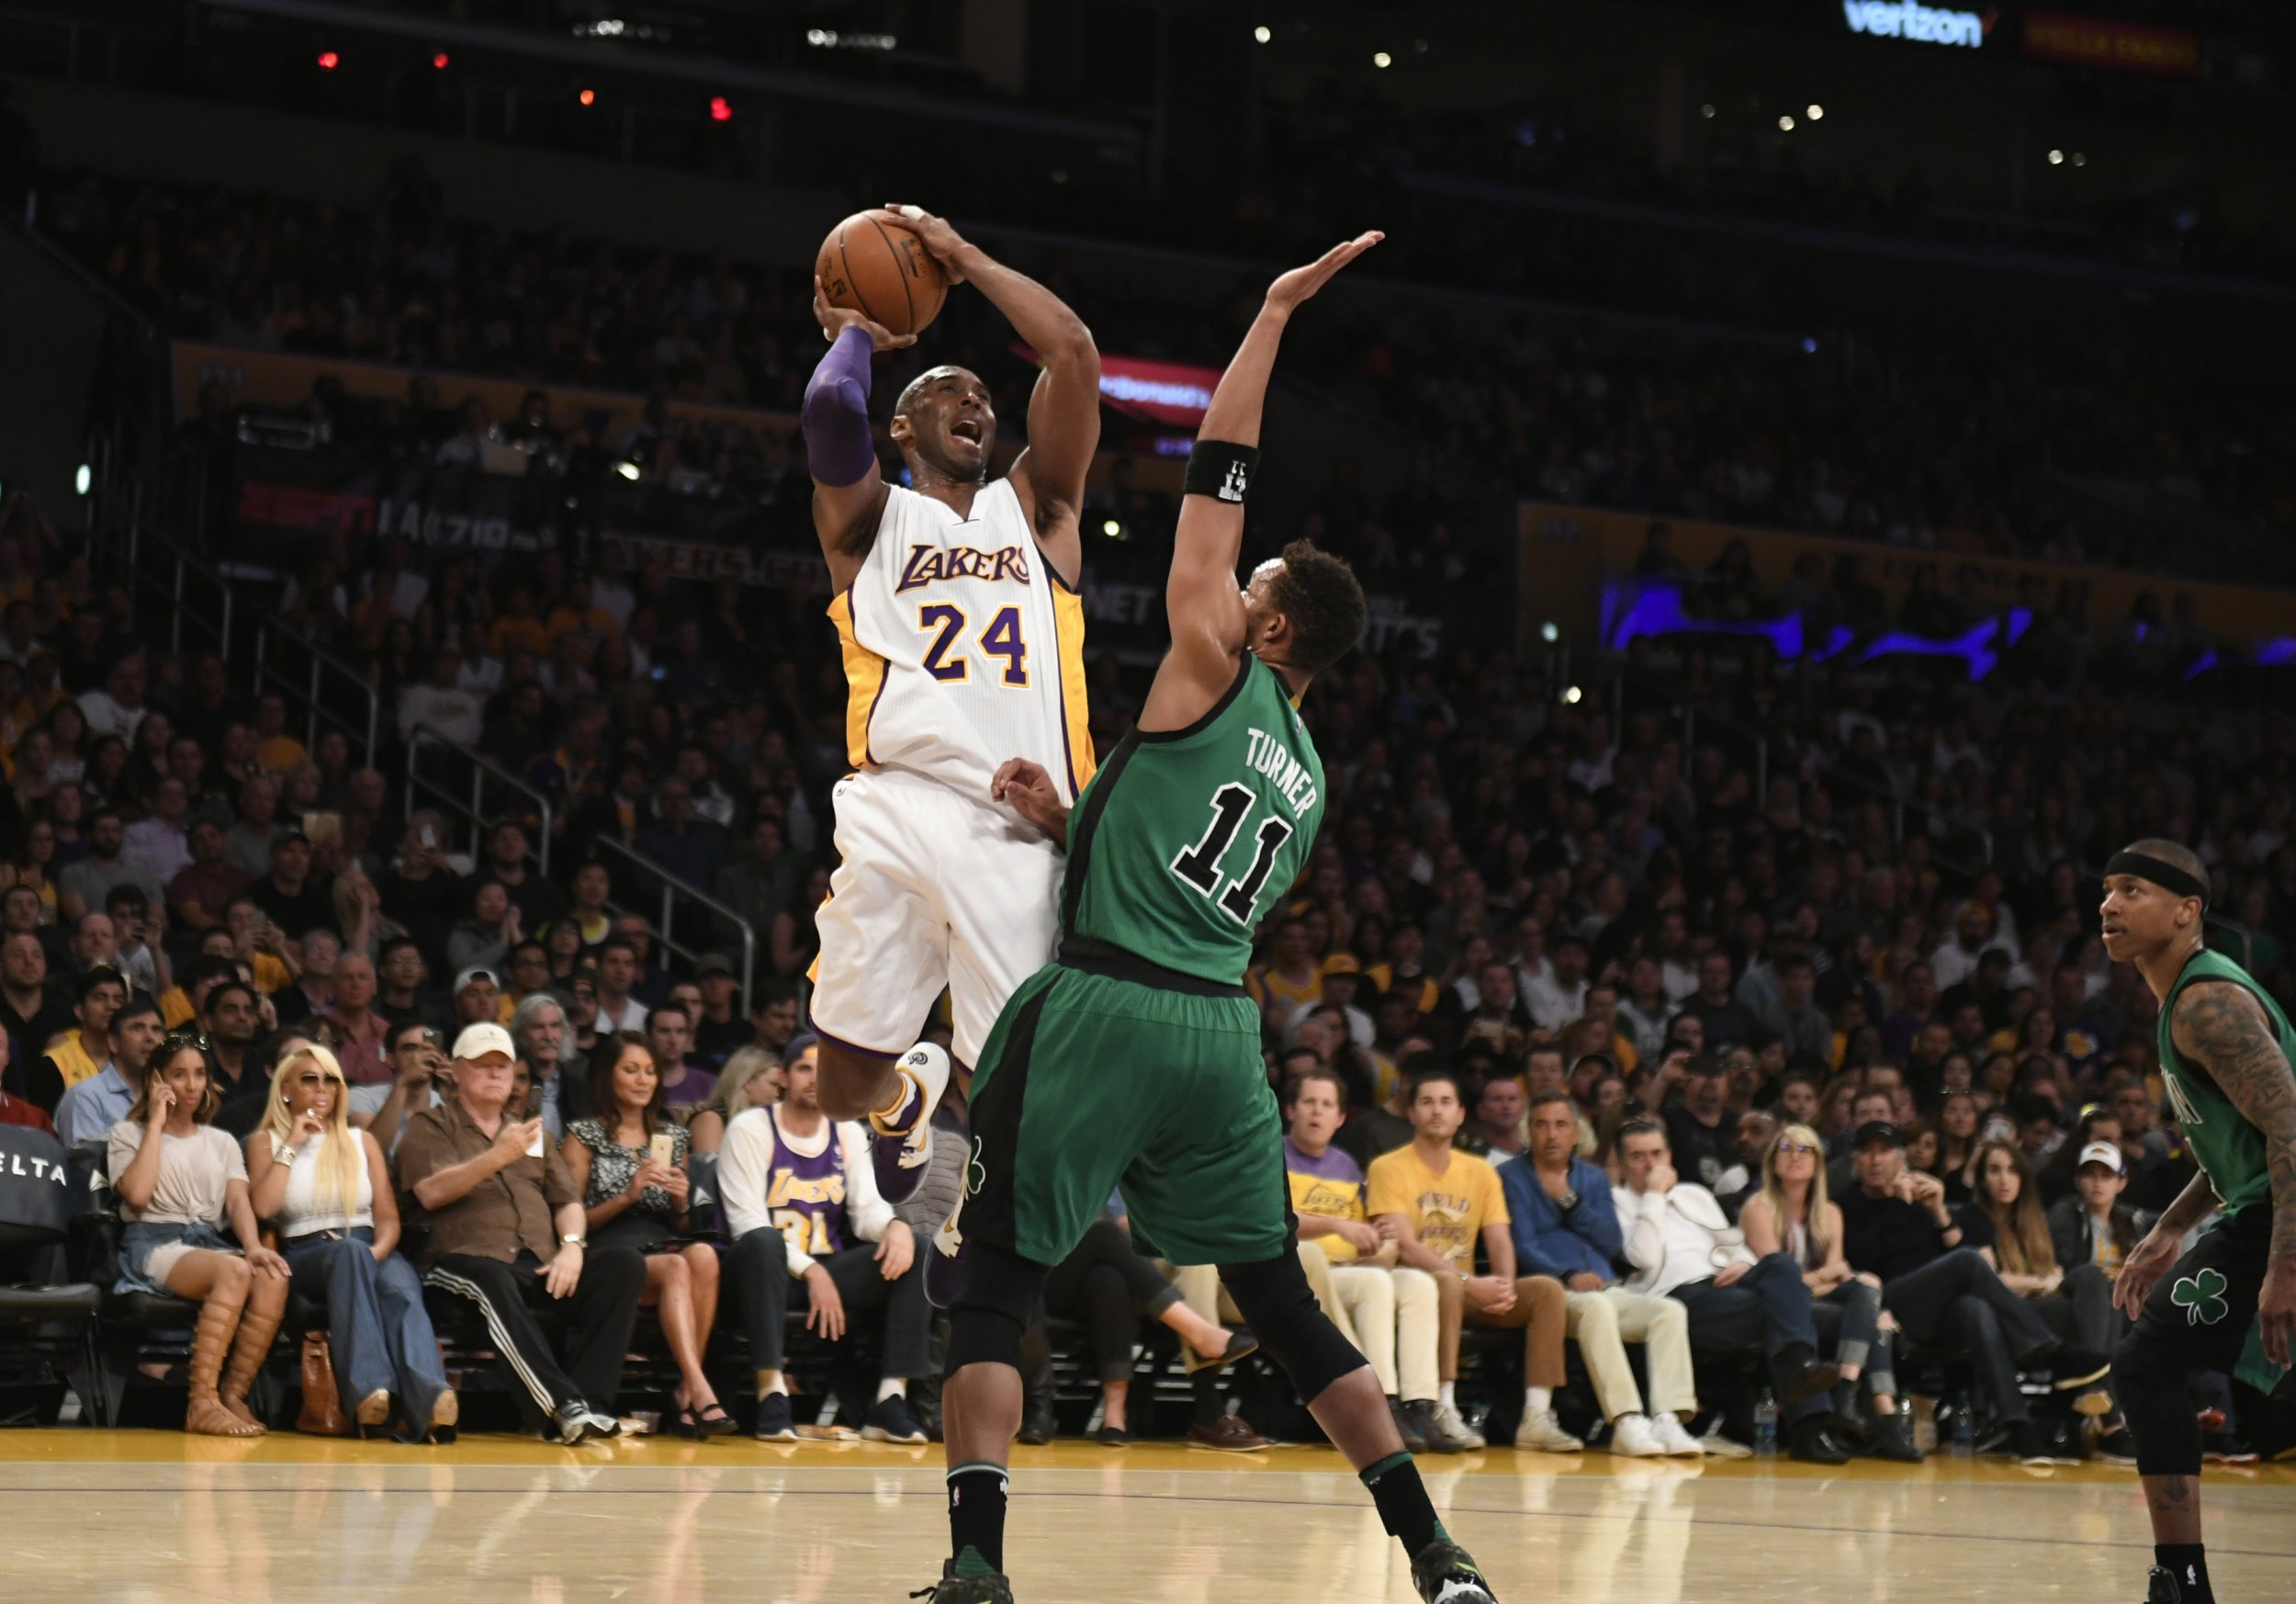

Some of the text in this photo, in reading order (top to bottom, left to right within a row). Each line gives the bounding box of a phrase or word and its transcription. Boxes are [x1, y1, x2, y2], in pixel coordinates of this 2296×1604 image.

[1842, 0, 1982, 49] verizon
[895, 544, 1031, 596] LAKERS
[917, 600, 1030, 689] 24
[1245, 727, 1318, 820] TURNER
[1169, 781, 1293, 927] 11
